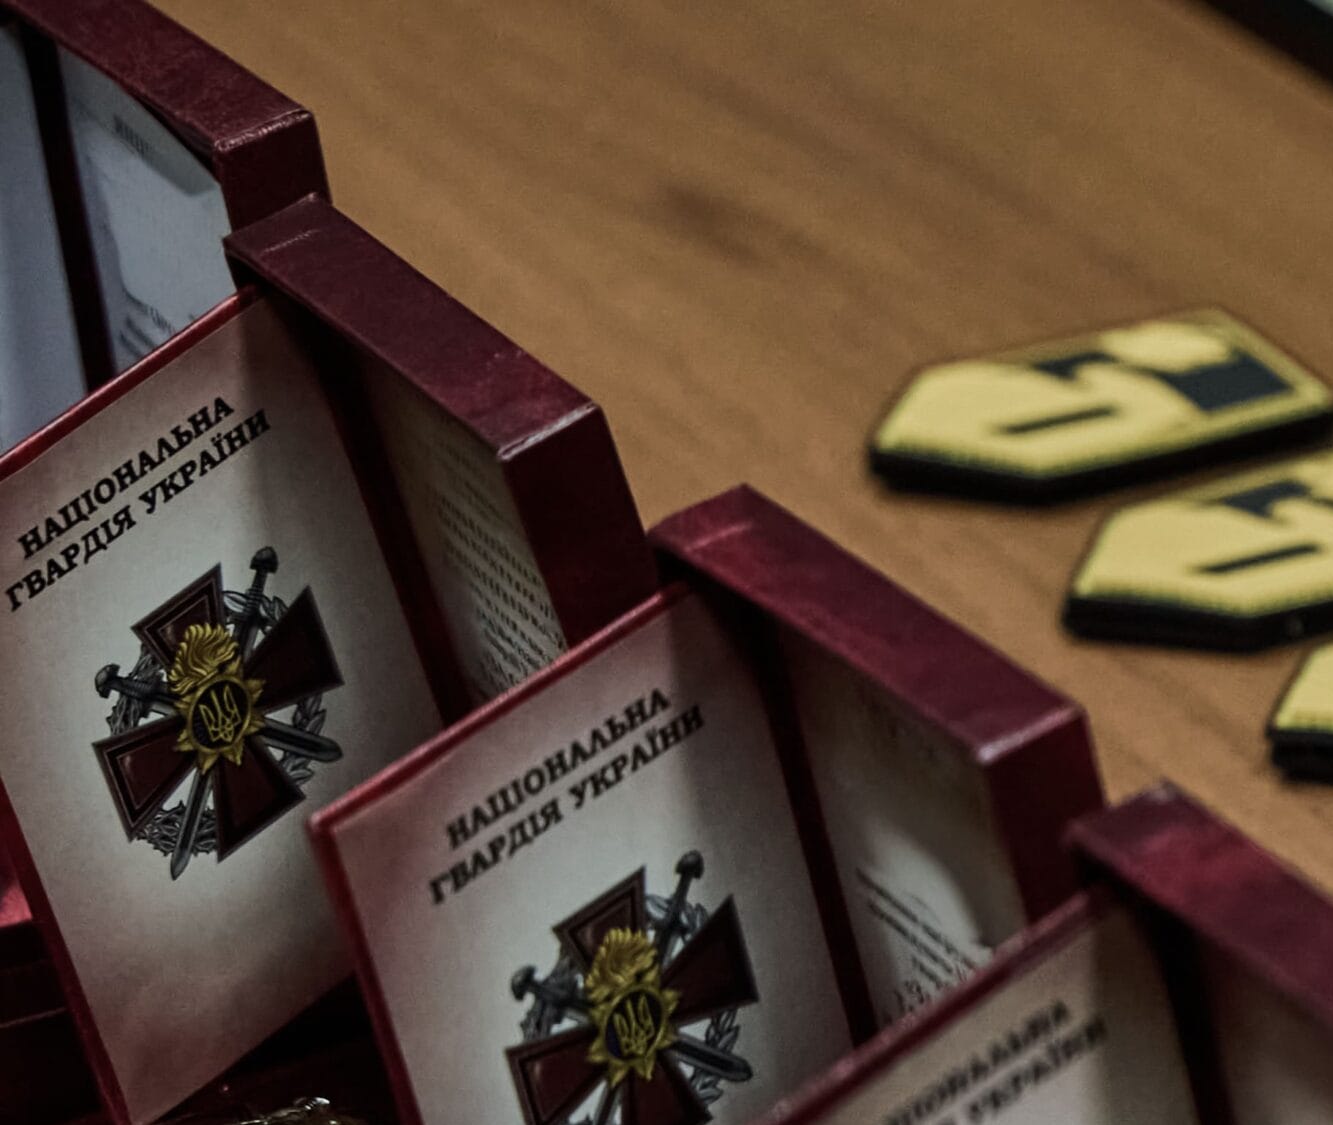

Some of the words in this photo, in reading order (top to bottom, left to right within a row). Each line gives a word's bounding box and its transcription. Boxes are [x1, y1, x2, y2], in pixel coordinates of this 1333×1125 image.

[4, 505, 137, 612] ГВАРДІЯ
[138, 408, 272, 515] УКРАЇНИ
[17, 396, 235, 560] НАЦІОНАЛЬНА
[429, 797, 564, 904] ГВАРДІЯ
[568, 704, 705, 810] УКРАЇНИ
[446, 687, 672, 850] НАЦІОНАЛЬНА
